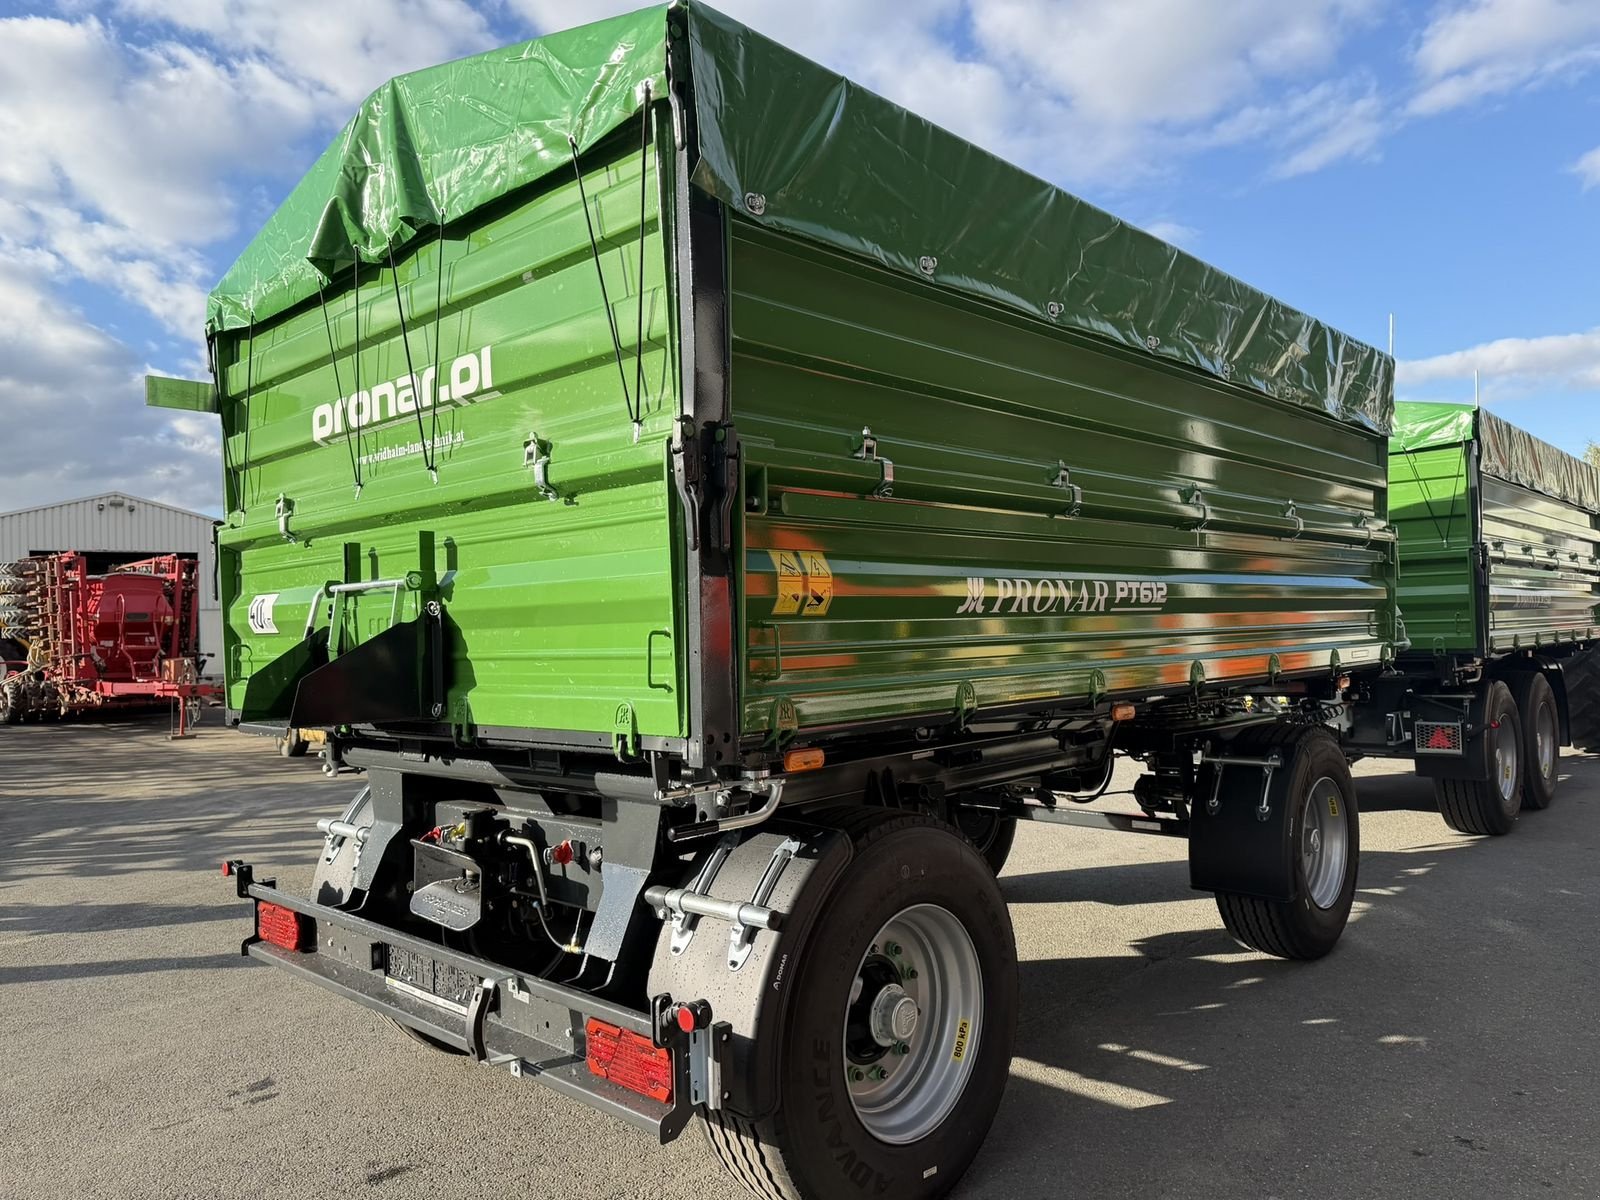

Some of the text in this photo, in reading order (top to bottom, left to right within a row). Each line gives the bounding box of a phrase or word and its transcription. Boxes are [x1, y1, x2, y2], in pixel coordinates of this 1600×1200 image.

[312, 345, 492, 442] pronar.pl
[989, 577, 1168, 613] PRONAR PT612
[953, 1022, 968, 1058] 800 kPa
[813, 1038, 896, 1194] ADVANCE
